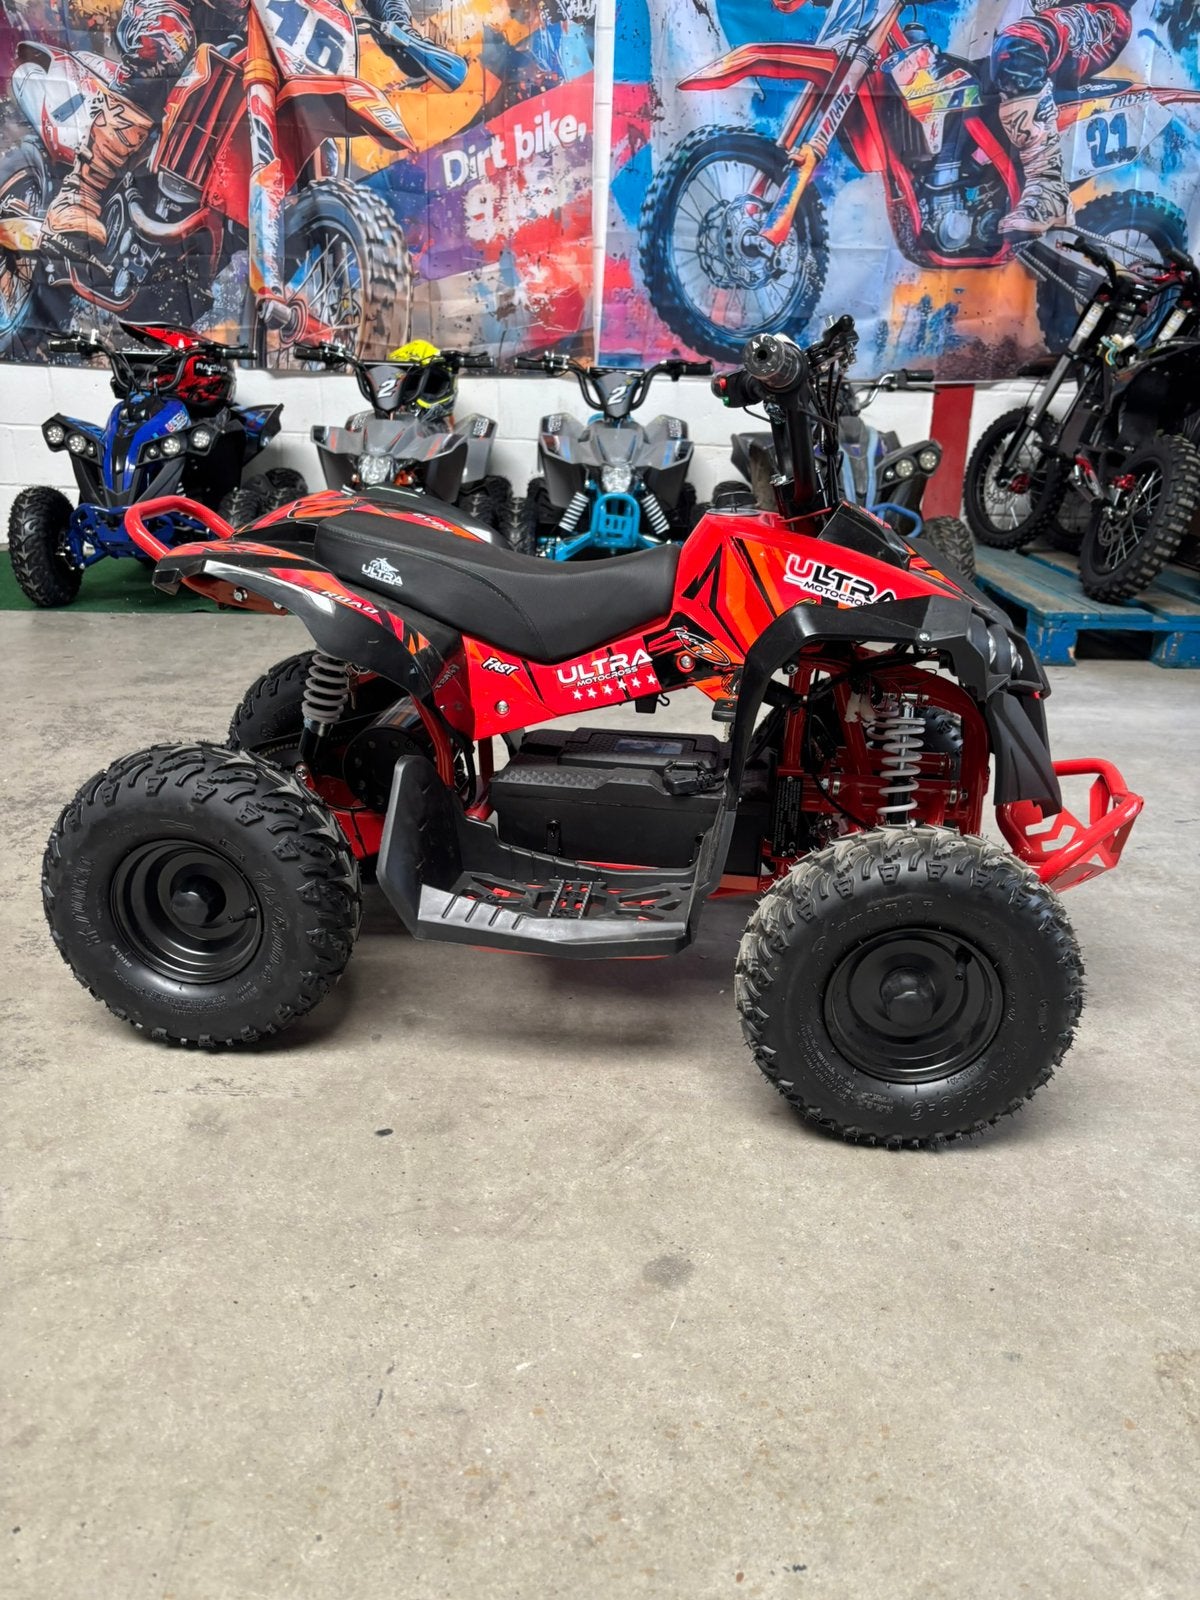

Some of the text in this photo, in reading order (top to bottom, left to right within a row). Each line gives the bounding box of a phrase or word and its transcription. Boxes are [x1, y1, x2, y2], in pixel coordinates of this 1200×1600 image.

[442, 110, 587, 189] Dirt bike,
[195, 361, 228, 373] RACING
[377, 379, 396, 398] 2
[607, 385, 627, 405] 2
[361, 563, 404, 586] ULTRA
[786, 553, 898, 603] ULTRA
[803, 580, 868, 606] MOTOCRO
[482, 656, 520, 676] FAST
[557, 648, 653, 684] ULTRA
[577, 665, 639, 687] MOTOCROSS
